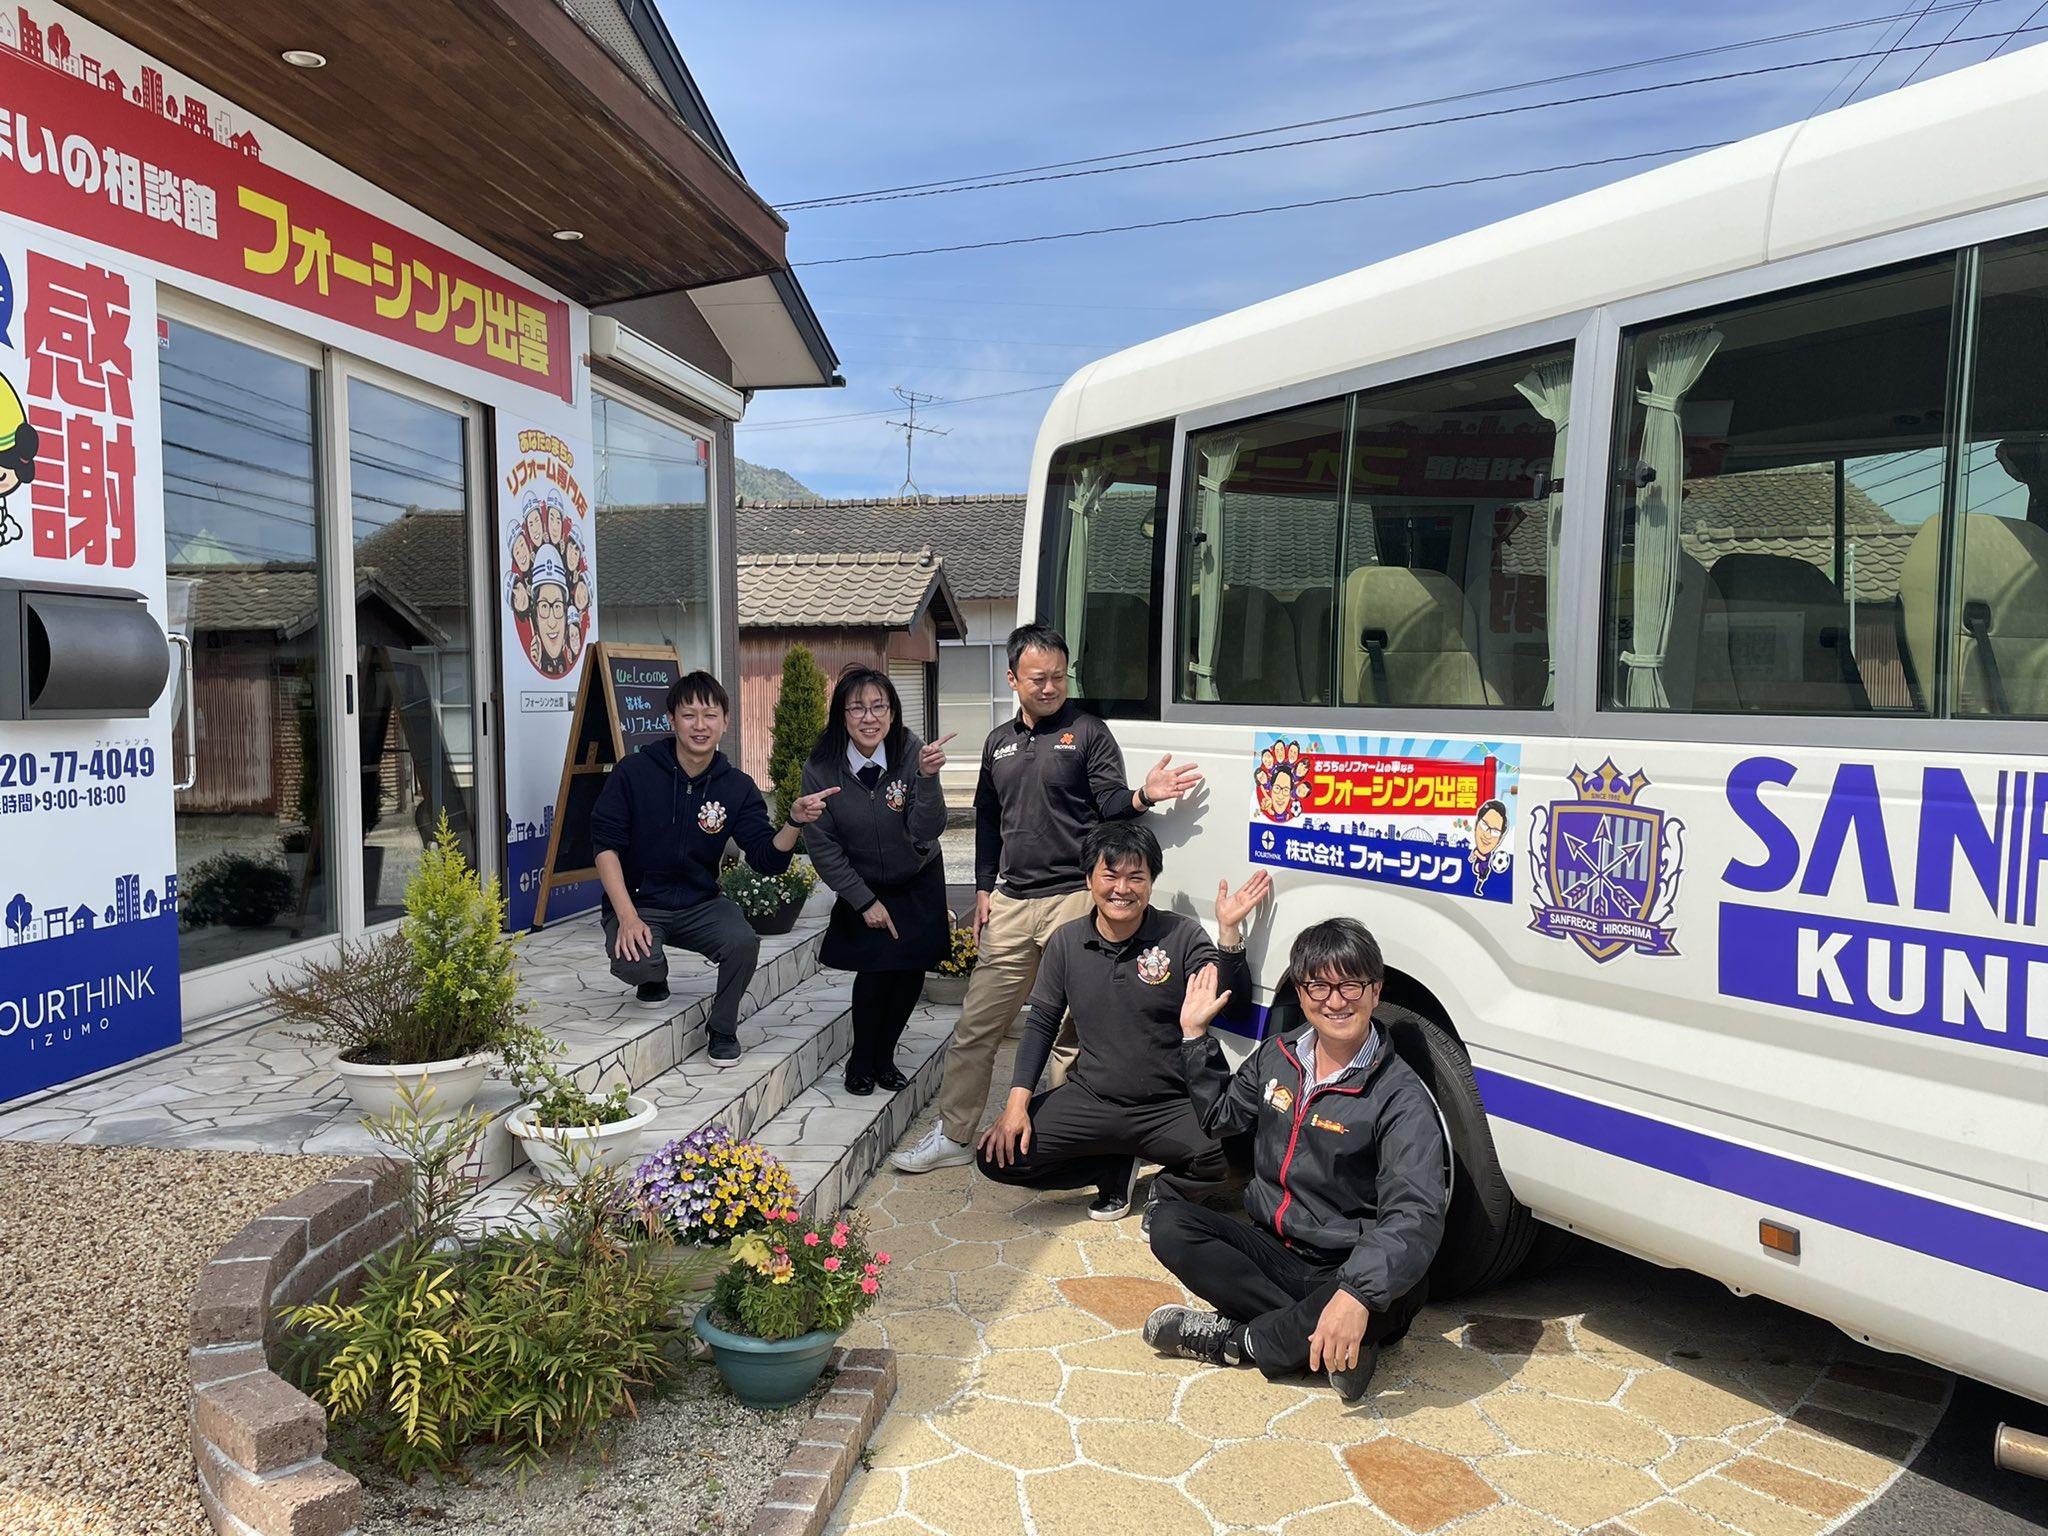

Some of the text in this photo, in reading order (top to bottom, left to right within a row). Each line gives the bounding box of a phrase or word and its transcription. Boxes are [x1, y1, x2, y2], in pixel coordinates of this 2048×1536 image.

[238, 185, 549, 376] フォーシンク出雲
[24, 249, 136, 569] 感謝
[518, 430, 574, 468] あなたのまちの
[506, 457, 588, 520] リフォーム専門店
[0, 747, 155, 787] 20-77-4049
[0, 793, 33, 814] 時間
[1314, 775, 1478, 809] フォーシンク出雲
[1285, 839, 1462, 884] 株式会社 フォーシンク
[1550, 913, 1652, 940] SANFRECCE HIROSHIMA
[0, 965, 156, 1036] OURTHINK
[30, 1017, 110, 1051] IZUMO
